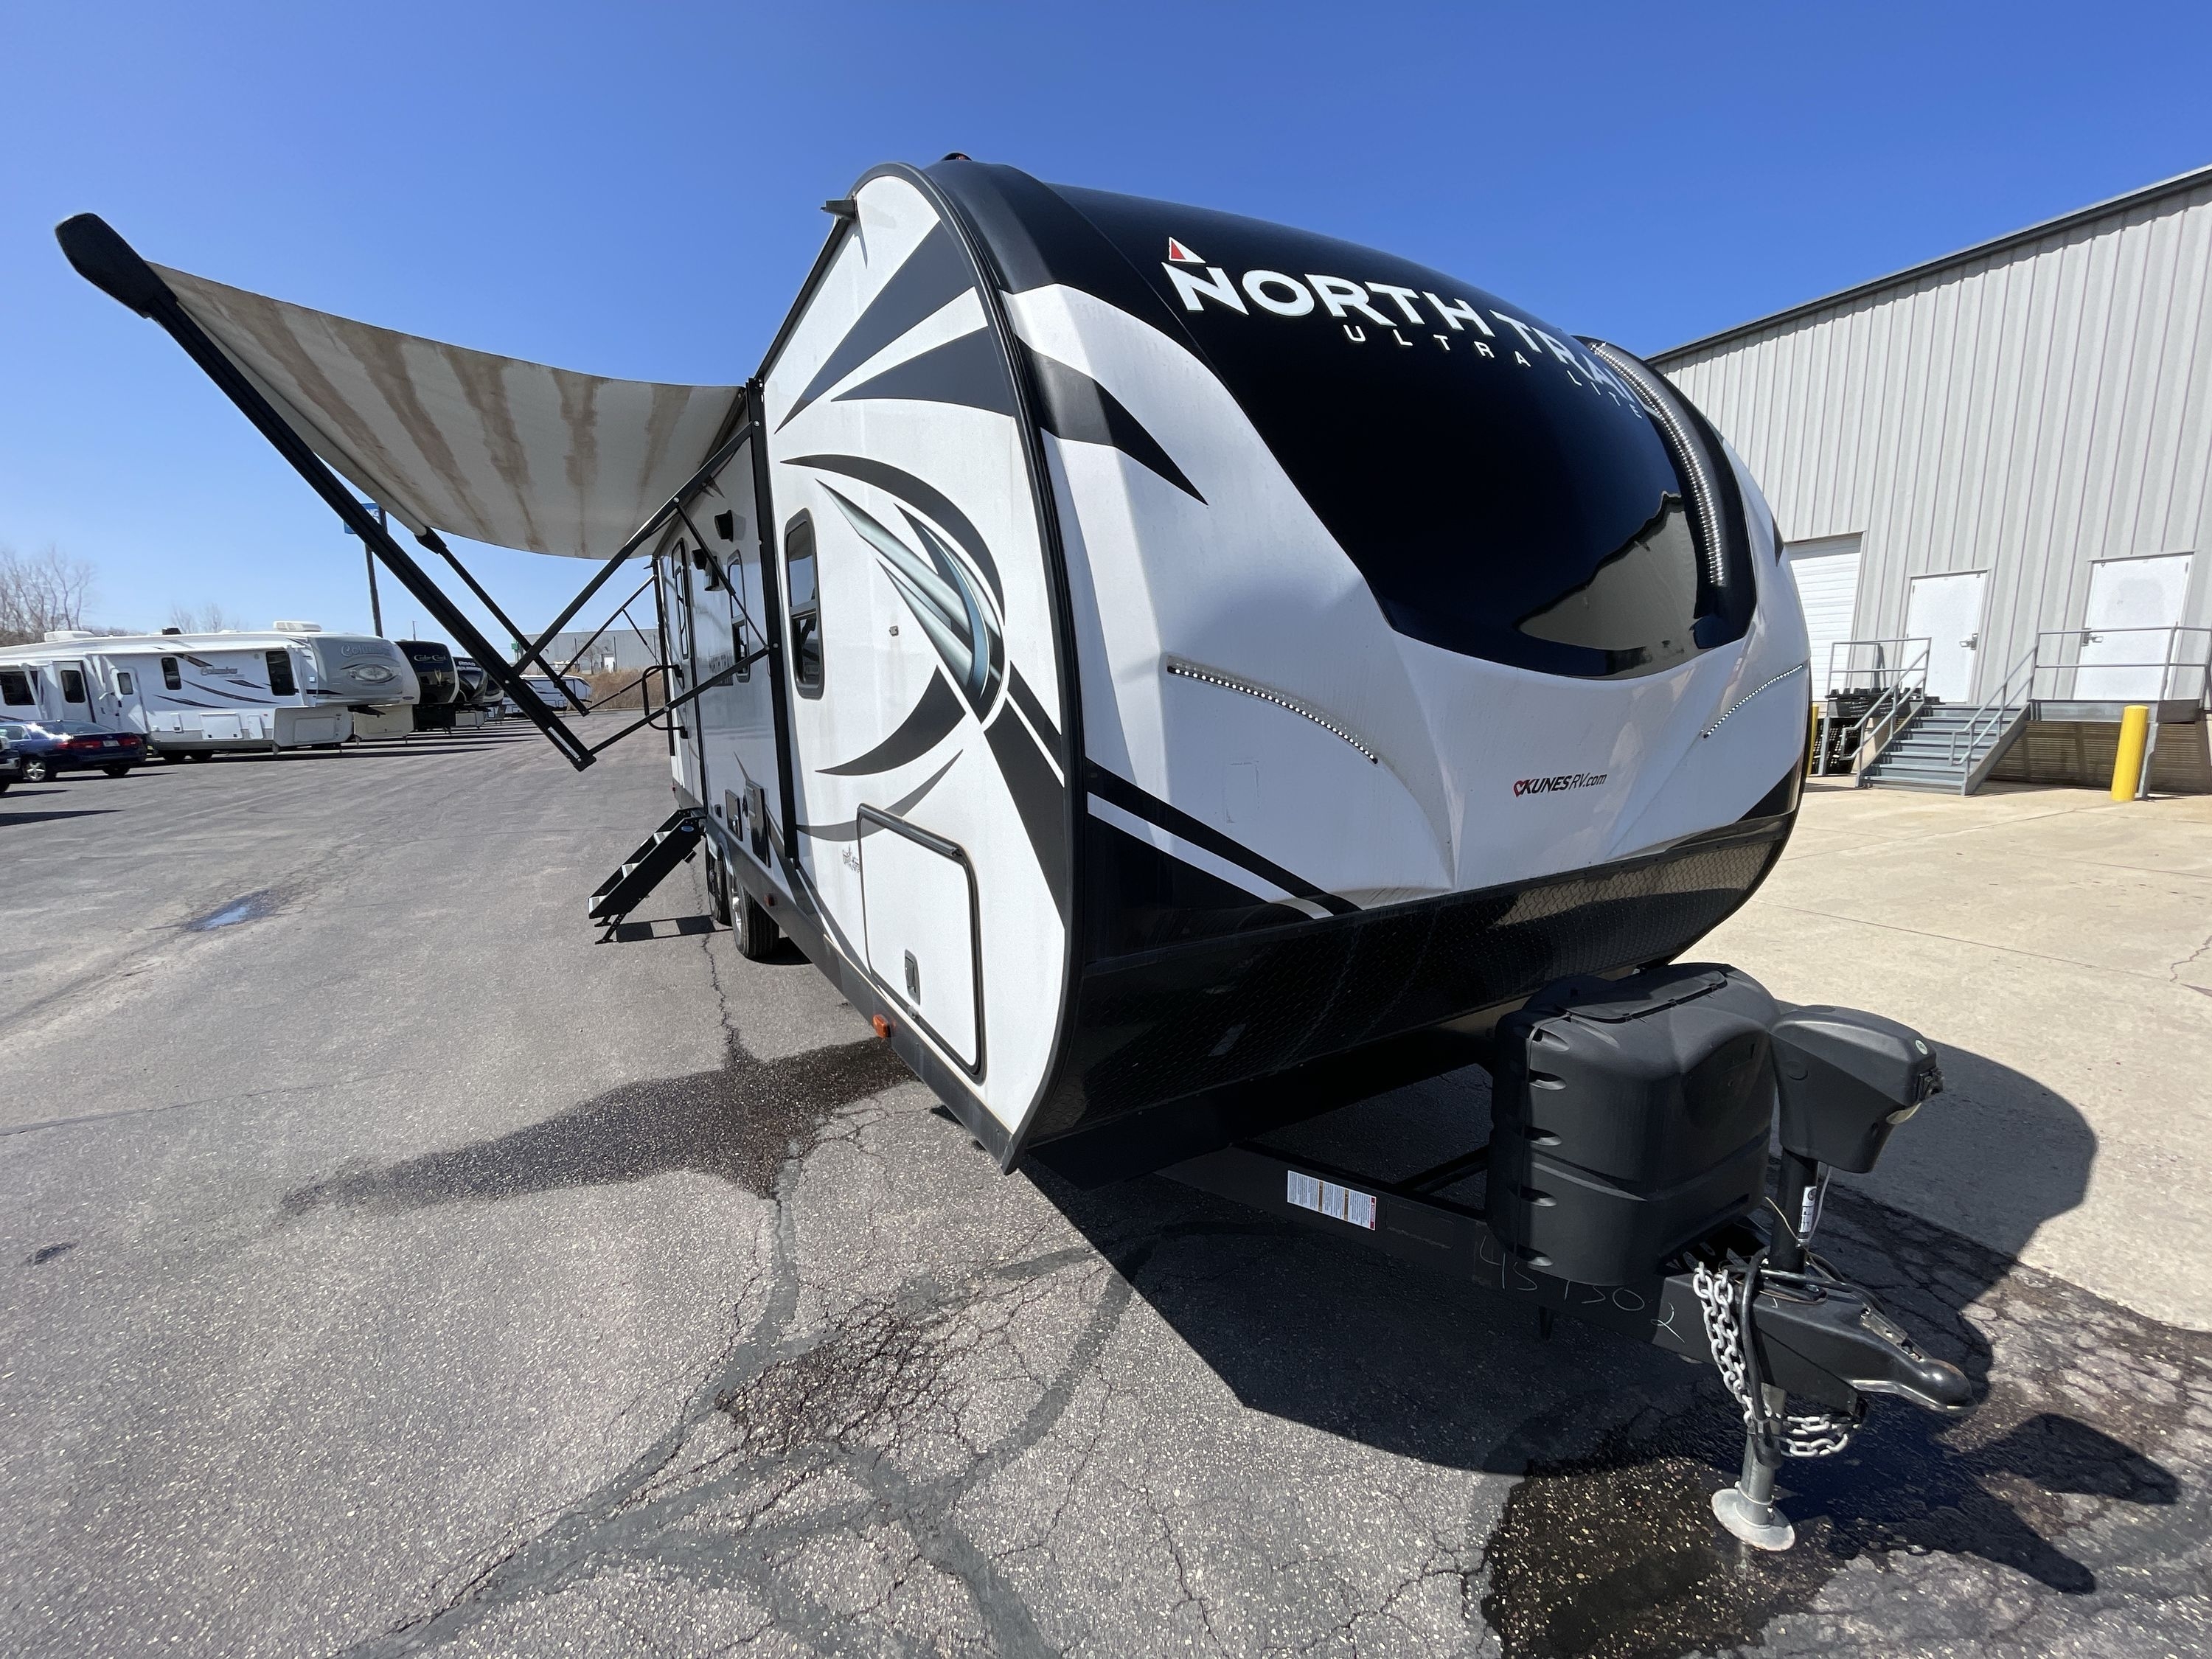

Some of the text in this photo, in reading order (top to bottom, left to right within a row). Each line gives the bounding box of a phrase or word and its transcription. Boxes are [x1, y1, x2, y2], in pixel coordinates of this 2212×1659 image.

[1161, 262, 1495, 338] NORTH
[1342, 324, 1643, 420] ULTRA LITE
